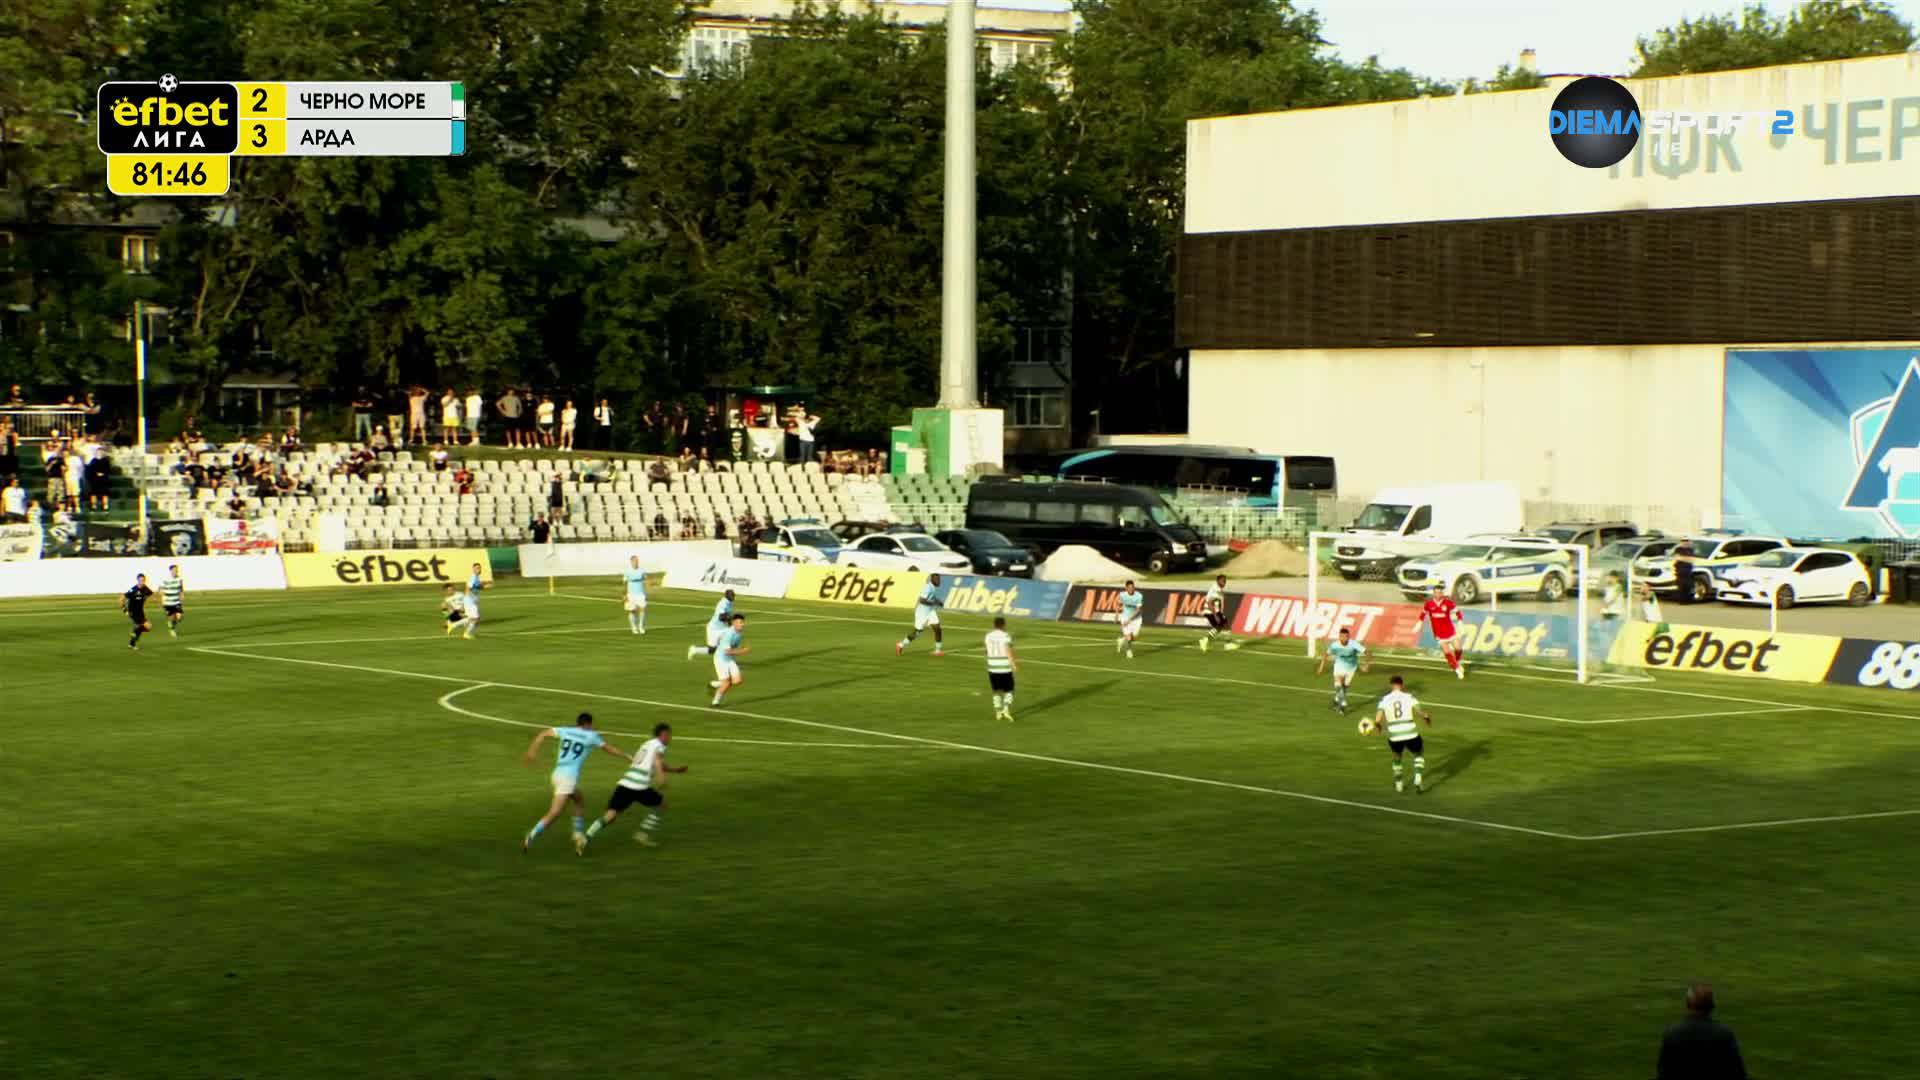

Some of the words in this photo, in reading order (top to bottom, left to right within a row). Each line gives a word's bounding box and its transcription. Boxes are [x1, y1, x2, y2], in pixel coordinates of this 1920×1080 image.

[333, 554, 450, 583] efbet
[819, 571, 894, 603] efbet
[1244, 597, 1384, 641] WINBET
[1644, 631, 1780, 672] efbet
[1392, 701, 1404, 719] 8
[561, 739, 584, 760] 99
